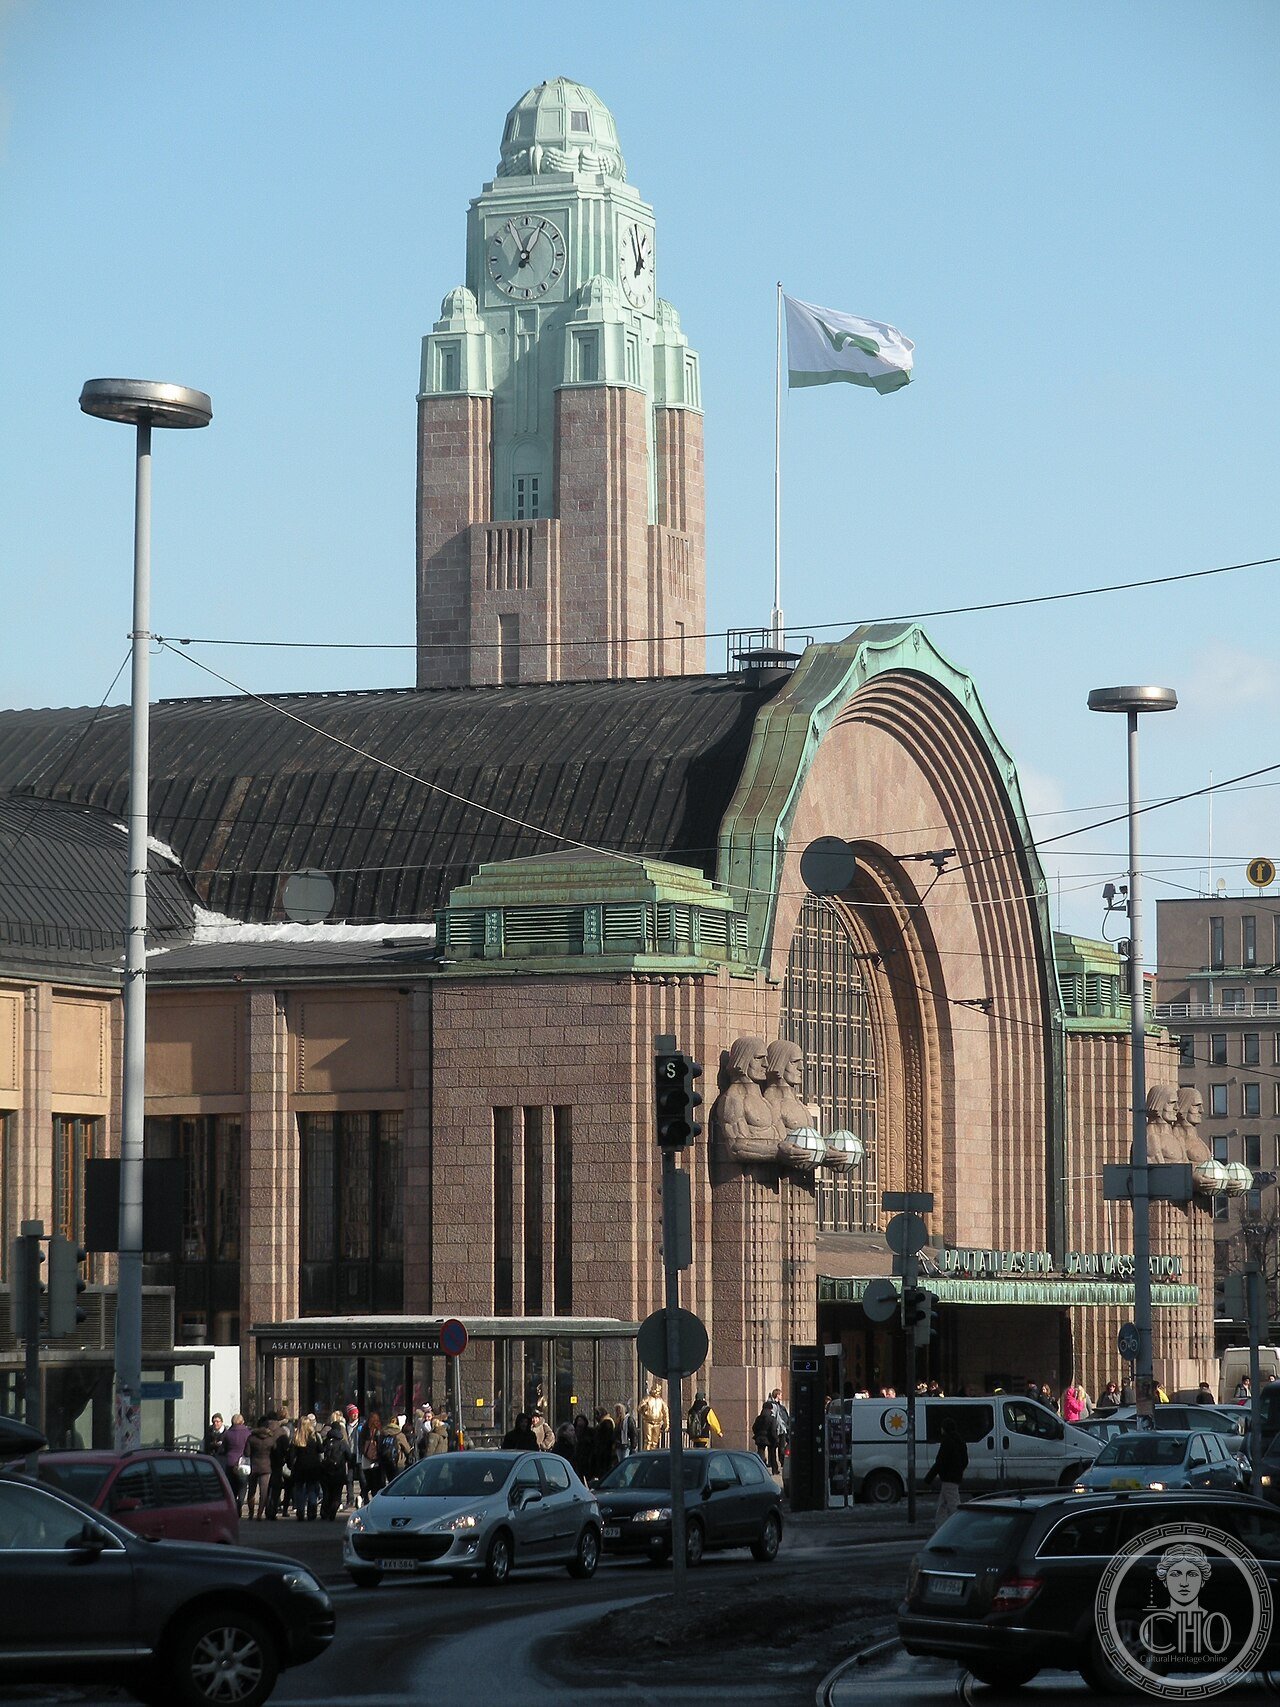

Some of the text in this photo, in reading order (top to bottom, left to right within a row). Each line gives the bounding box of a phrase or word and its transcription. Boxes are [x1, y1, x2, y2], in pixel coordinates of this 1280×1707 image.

[666, 1062, 676, 1078] S
[944, 1250, 1054, 1273] RAUTATIEASEMA
[271, 1341, 440, 1350] ASEMATUNNELI STATIONSTUNNELN
